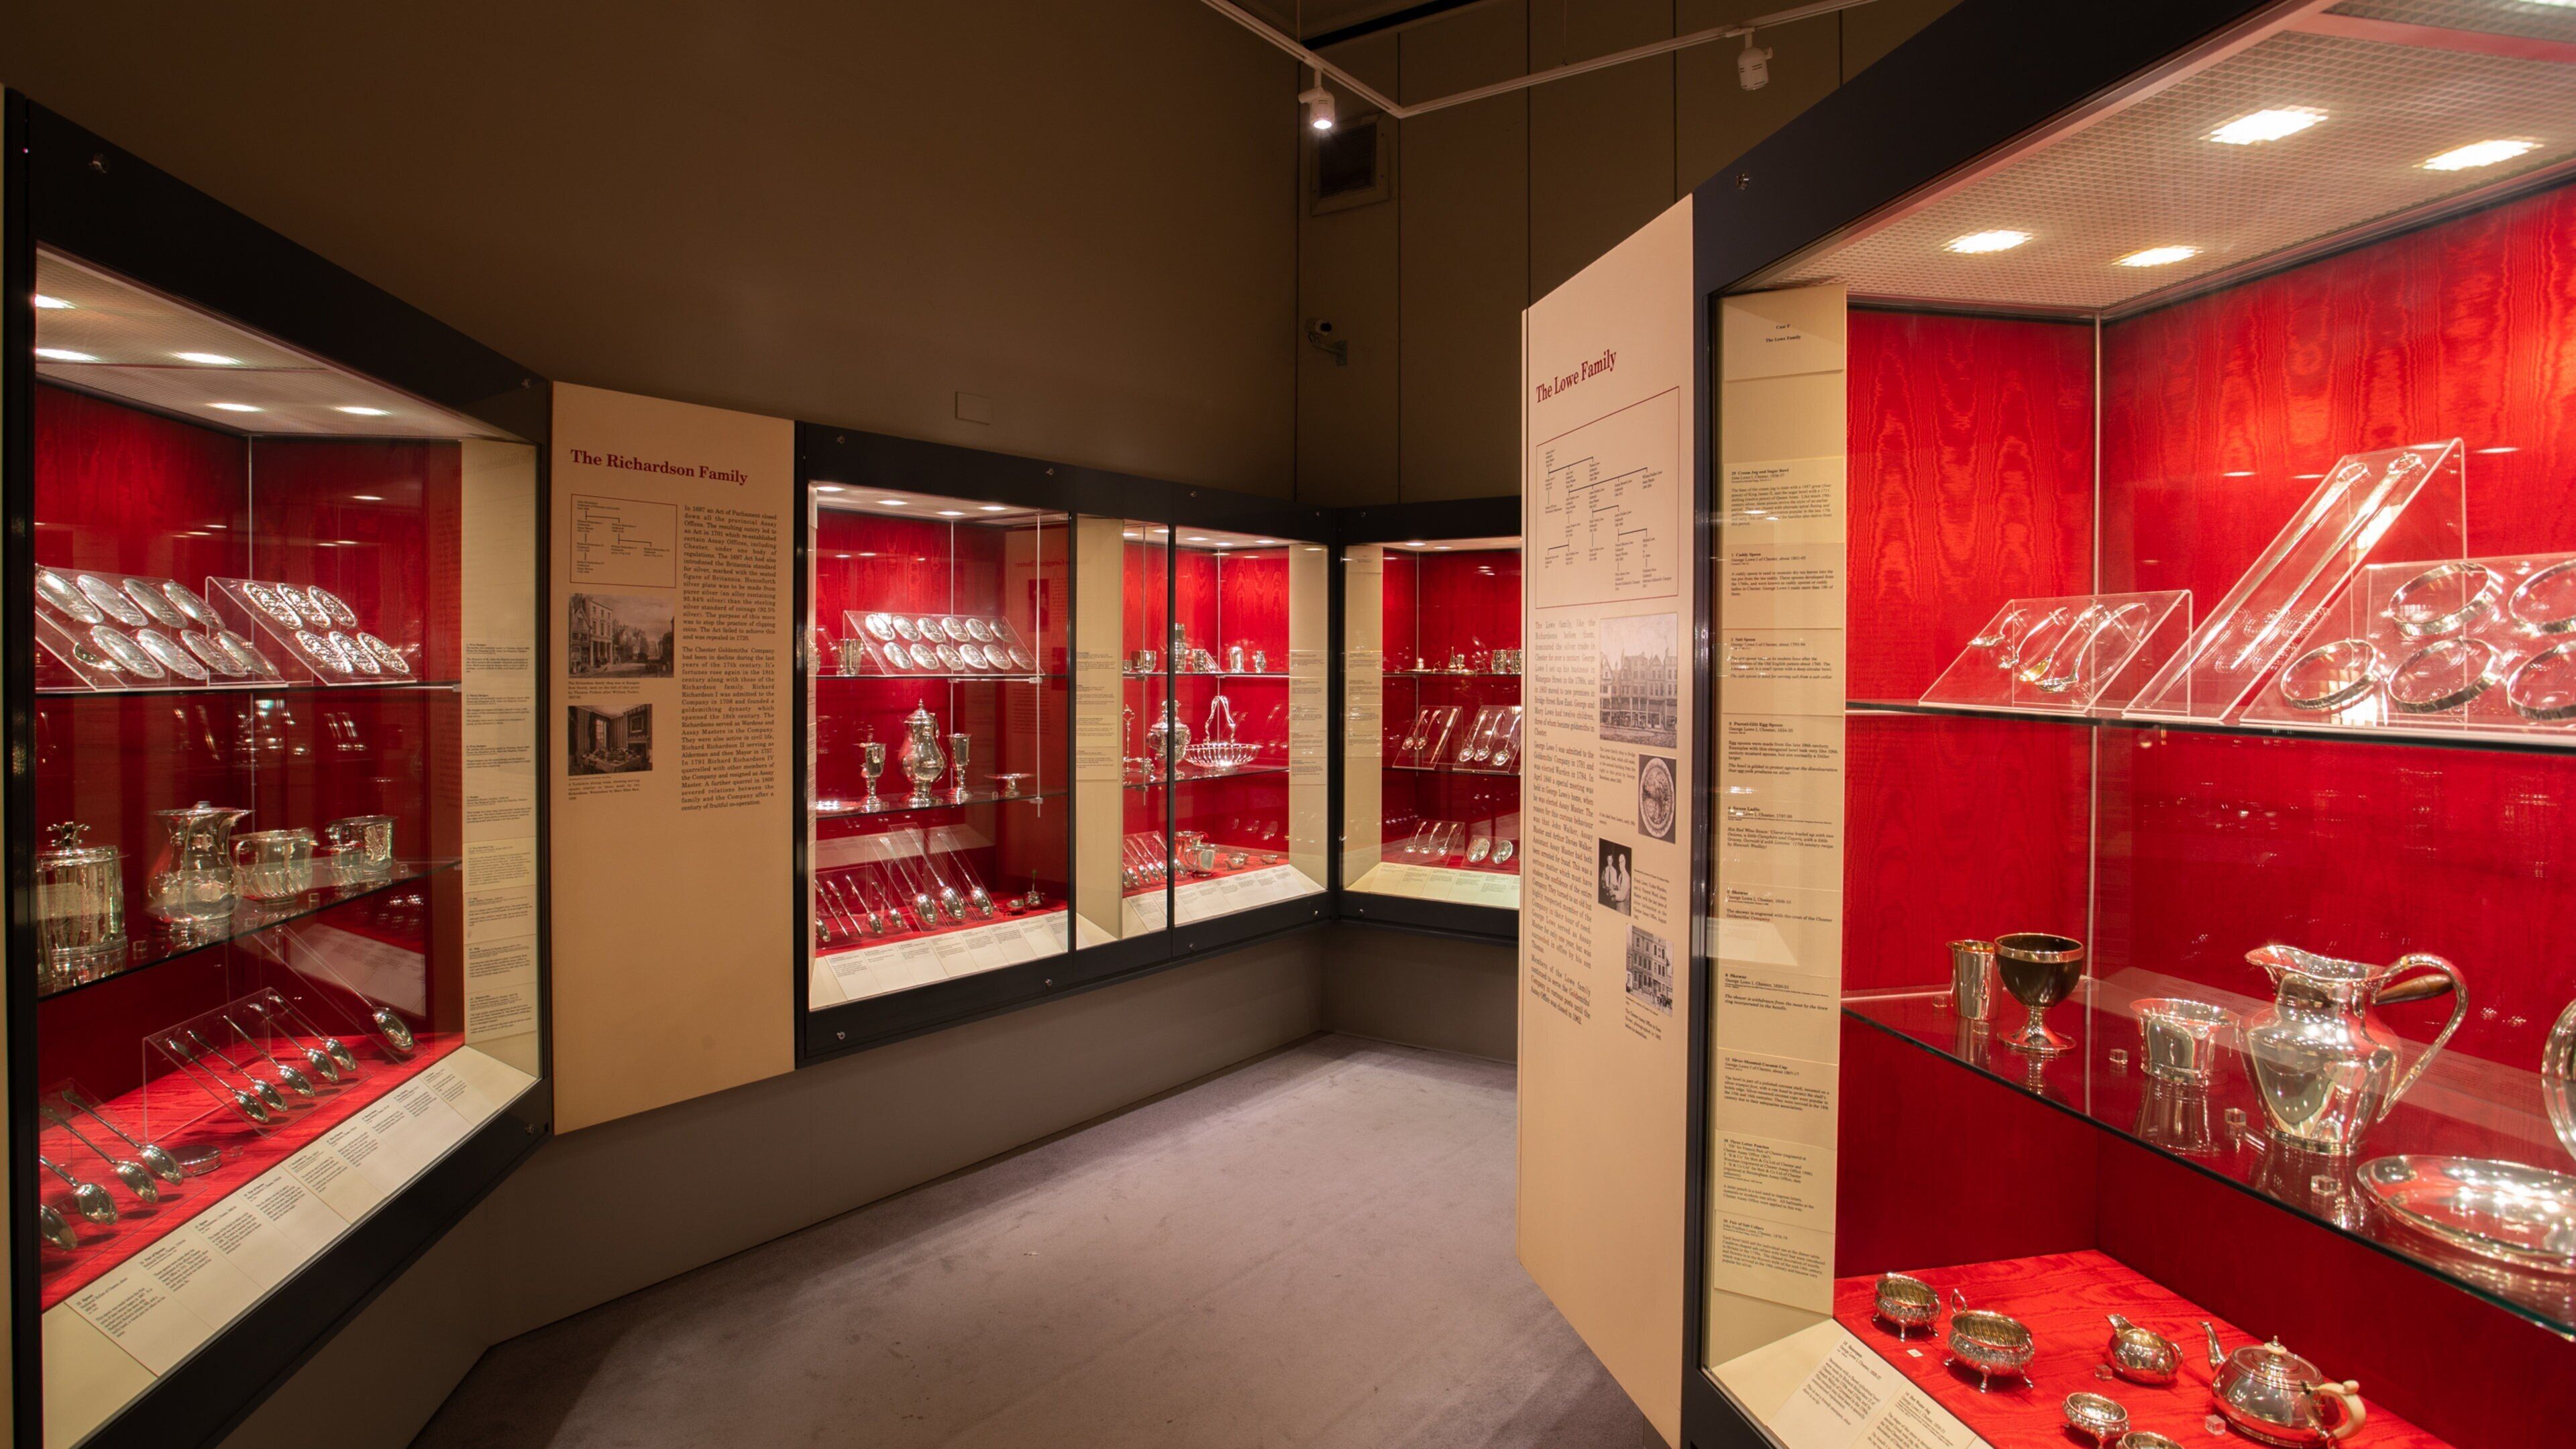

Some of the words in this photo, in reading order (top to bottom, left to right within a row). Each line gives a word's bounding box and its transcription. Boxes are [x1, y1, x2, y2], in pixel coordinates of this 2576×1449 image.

[1536, 383, 1552, 403] The
[1554, 376, 1579, 394] Lowe
[1580, 349, 1617, 381] Family
[571, 449, 602, 466] The
[606, 453, 695, 477] Richardson
[698, 466, 748, 486] Family
[728, 517, 757, 525] provincial
[718, 523, 743, 531] resulting
[750, 541, 776, 549] including
